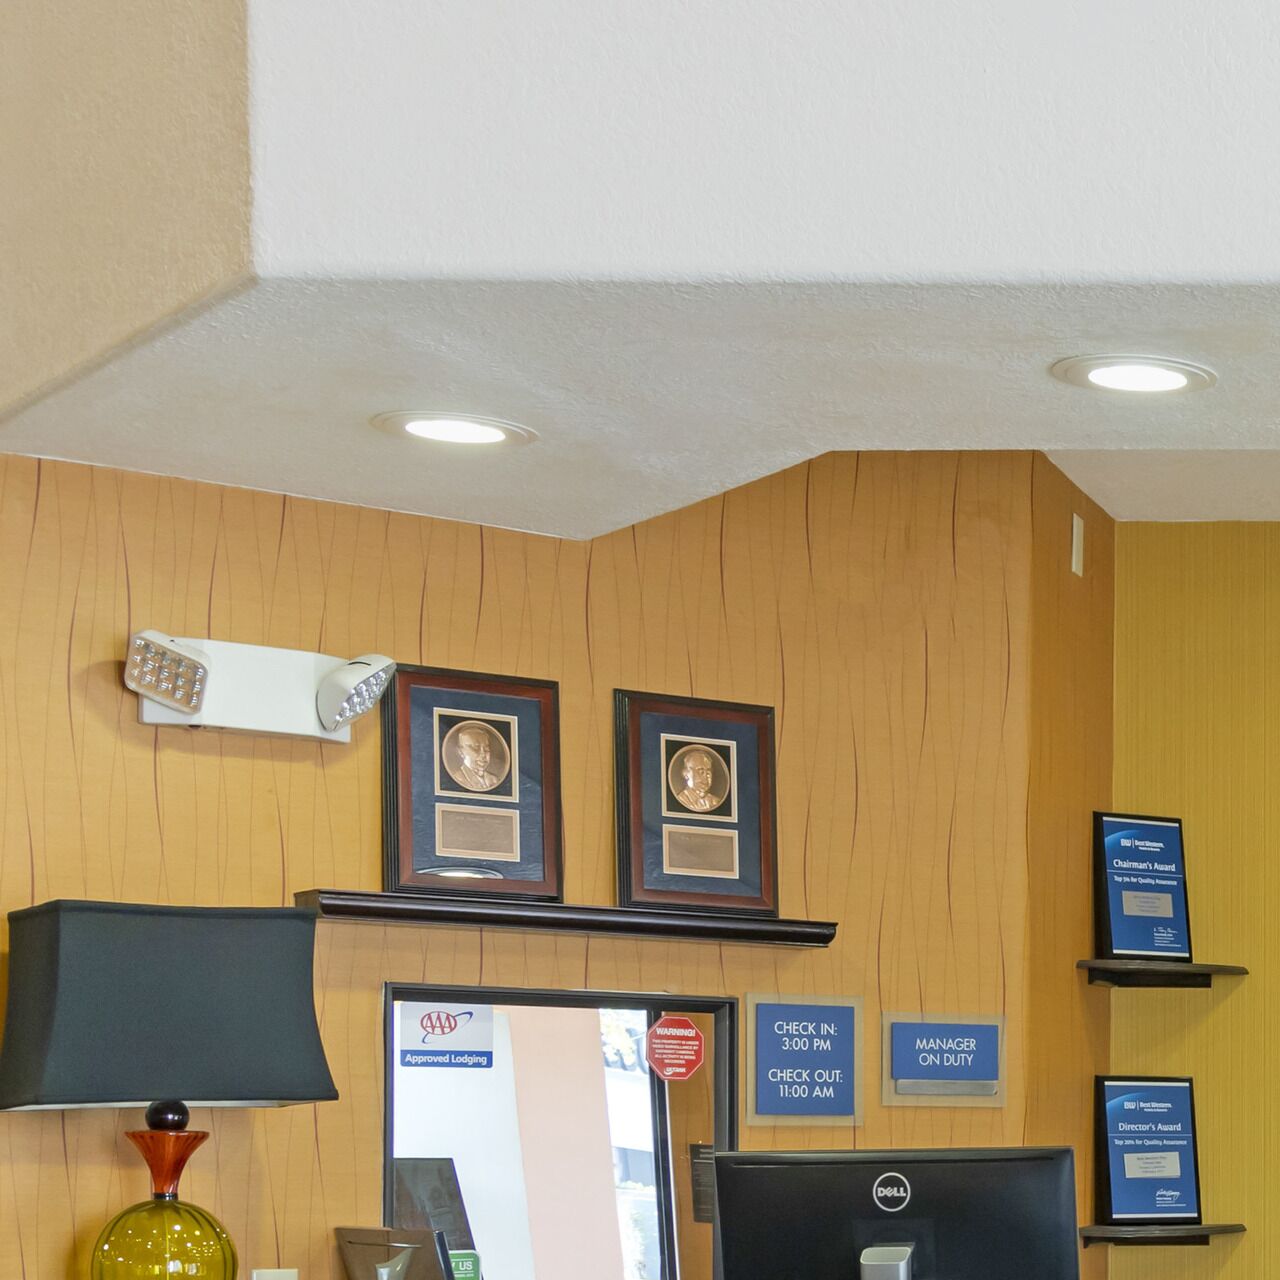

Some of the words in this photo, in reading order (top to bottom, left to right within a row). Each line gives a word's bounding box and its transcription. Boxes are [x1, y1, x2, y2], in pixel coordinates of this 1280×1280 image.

[1113, 859, 1152, 870] Chairman's
[1154, 862, 1176, 872] Award
[424, 1012, 455, 1035] AAA
[774, 1022, 816, 1035] CHECK
[820, 1023, 838, 1036] IN:
[656, 1028, 696, 1037] WARNING!
[782, 1038, 809, 1051] 3:00
[814, 1039, 831, 1051] PM
[916, 1038, 976, 1051] MANAGER
[405, 1054, 450, 1064] Approved
[451, 1054, 488, 1066] Lodging
[919, 1053, 941, 1066] ON
[944, 1054, 974, 1066] DUTY
[768, 1069, 810, 1082] CHECK
[814, 1070, 843, 1083] OUT:
[779, 1085, 808, 1098] 11:00
[812, 1085, 834, 1098] AM
[1118, 1122, 1155, 1131] Director's
[1157, 1123, 1181, 1131] Award
[877, 1186, 907, 1197] DELL
[459, 1261, 473, 1270] US
